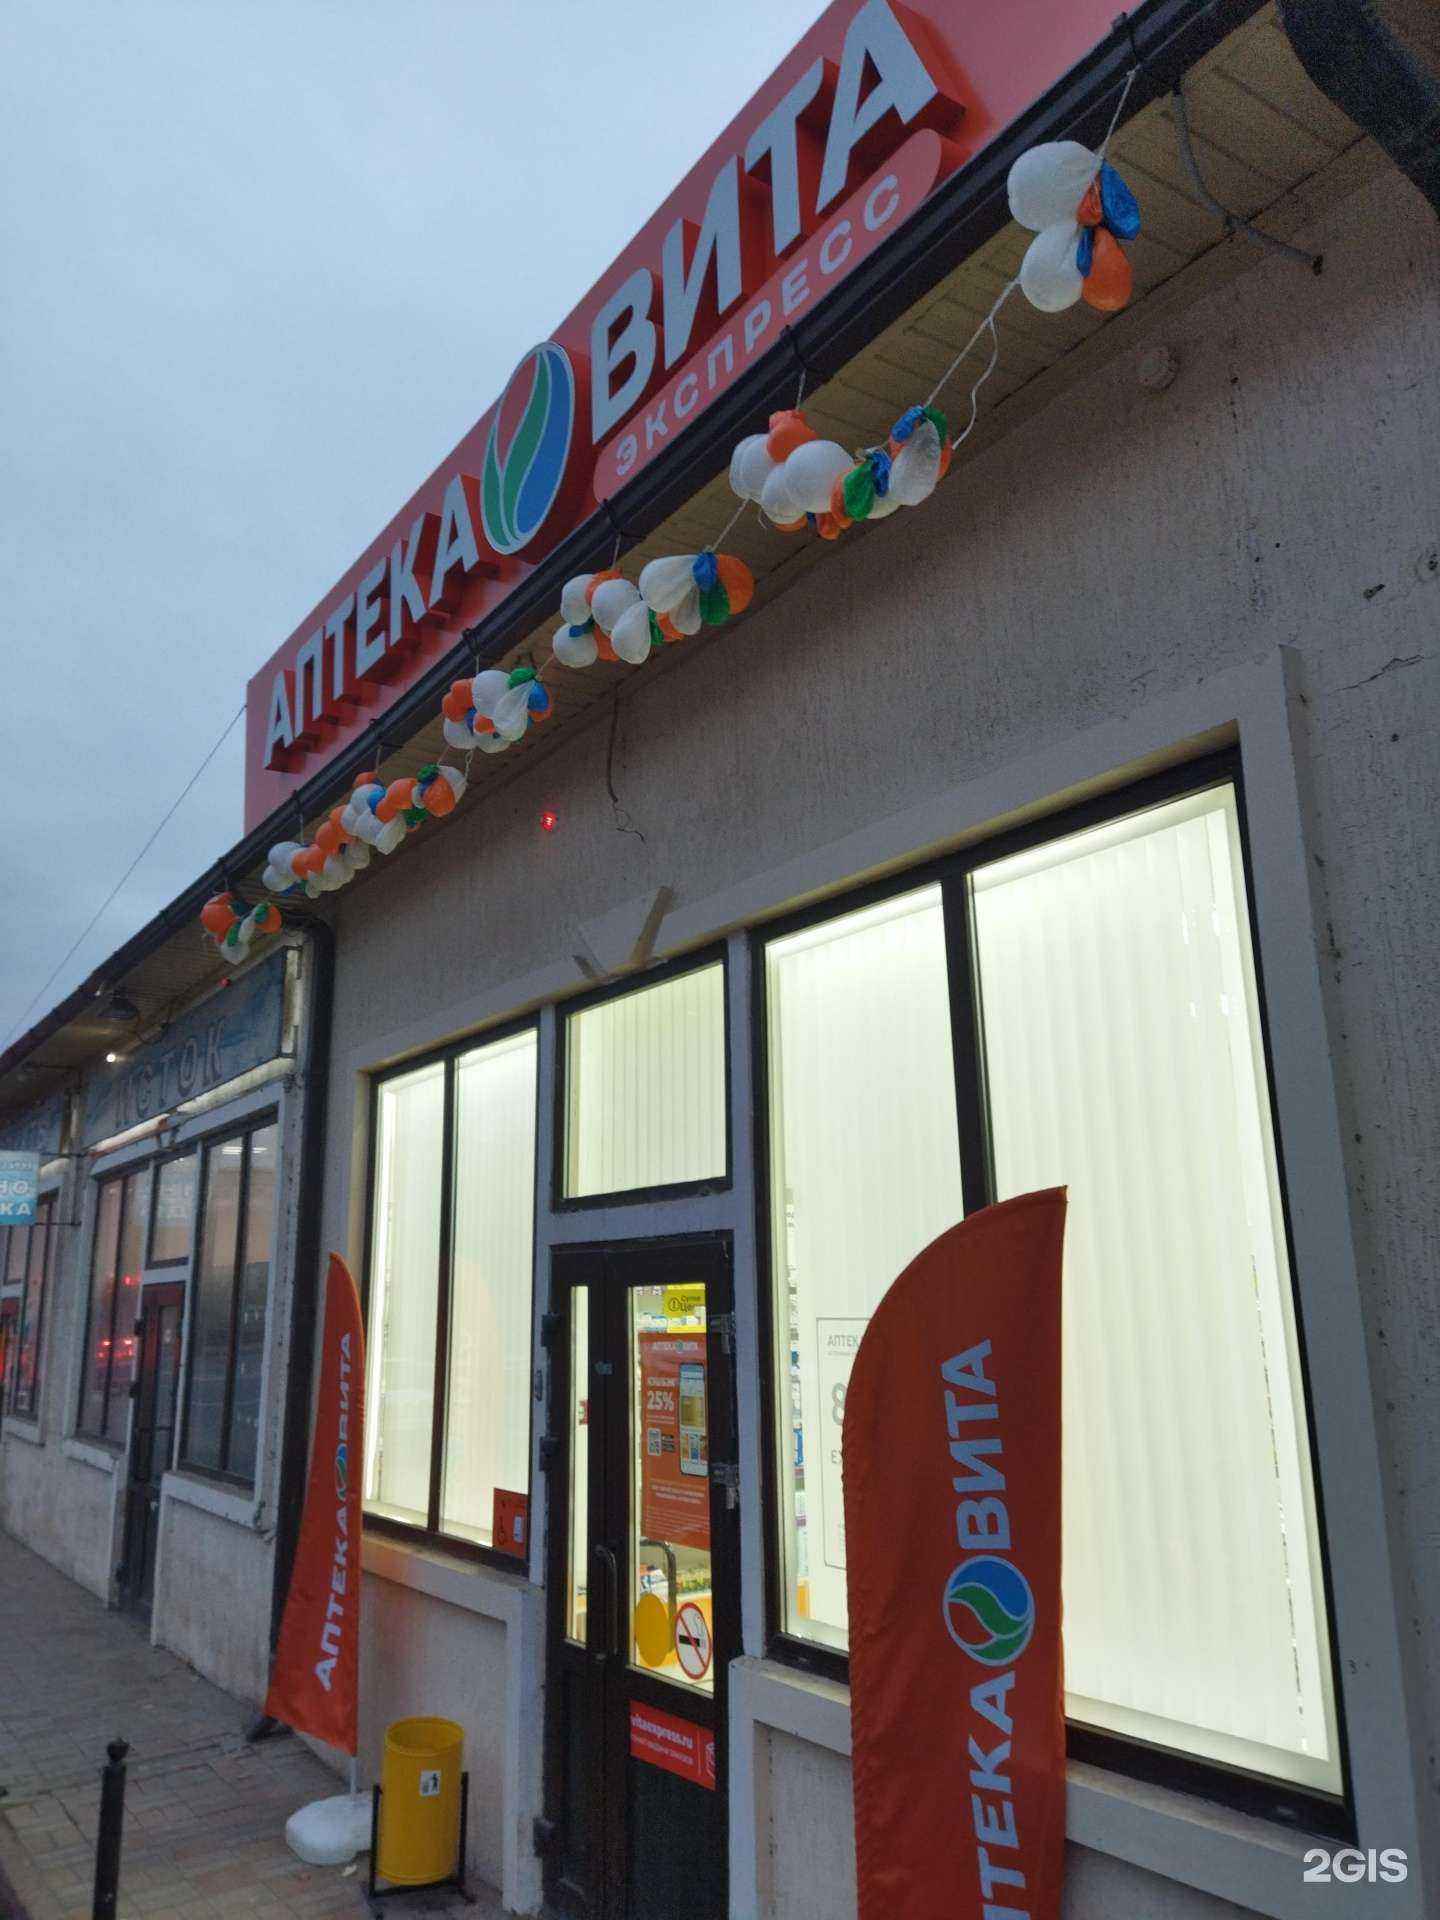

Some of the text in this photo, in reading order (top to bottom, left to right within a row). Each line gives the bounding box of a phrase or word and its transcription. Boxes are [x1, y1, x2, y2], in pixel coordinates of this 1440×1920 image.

[263, 0, 938, 769] АПТЕКА ВИТА
[616, 174, 901, 476] ЭКСПРЕСС
[647, 1390, 675, 1412] 25%
[827, 1334, 860, 1348] АПТЕК
[940, 1338, 1012, 1550] ВИТА
[314, 1332, 352, 1691] АПТЕКА ВИТА
